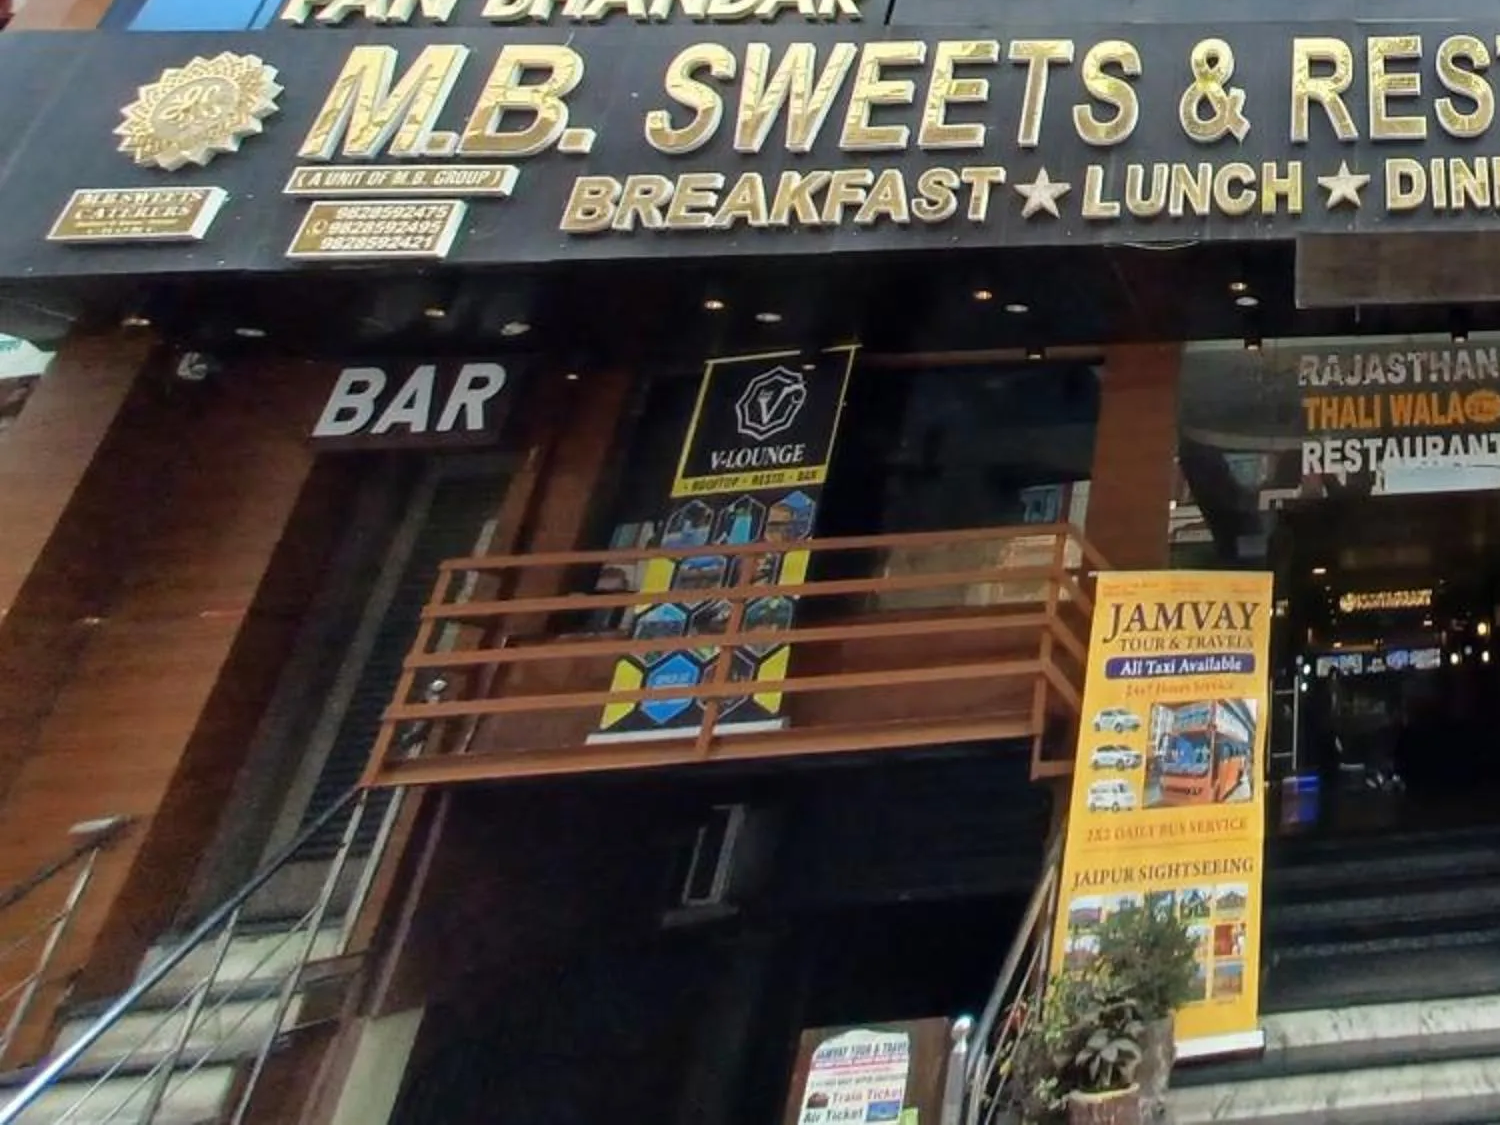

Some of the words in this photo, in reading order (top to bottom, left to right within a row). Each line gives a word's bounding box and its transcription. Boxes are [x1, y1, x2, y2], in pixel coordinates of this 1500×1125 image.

[298, 43, 597, 162] M.B.
[644, 39, 1142, 155] SWEETS
[1178, 37, 1252, 145] &
[559, 165, 1006, 232] BREAKFAST
[1082, 160, 1303, 221] LUNCH
[1298, 347, 1500, 386] RAJASTHAN
[311, 362, 507, 438] BAR
[1304, 394, 1382, 431] THALI
[1389, 390, 1466, 428] WALA
[711, 443, 806, 470] V-LOUNGE
[1102, 600, 1261, 644] JAMVAY
[1120, 638, 1165, 652] TOUR
[1168, 636, 1181, 650] &
[1120, 659, 1142, 676] All
[1147, 658, 1176, 675] Taxi
[1182, 655, 1242, 673] Available
[1189, 817, 1249, 835] SERVICE
[1071, 867, 1135, 891] JAIPUR
[1139, 857, 1255, 884] SIGHTSEEING
